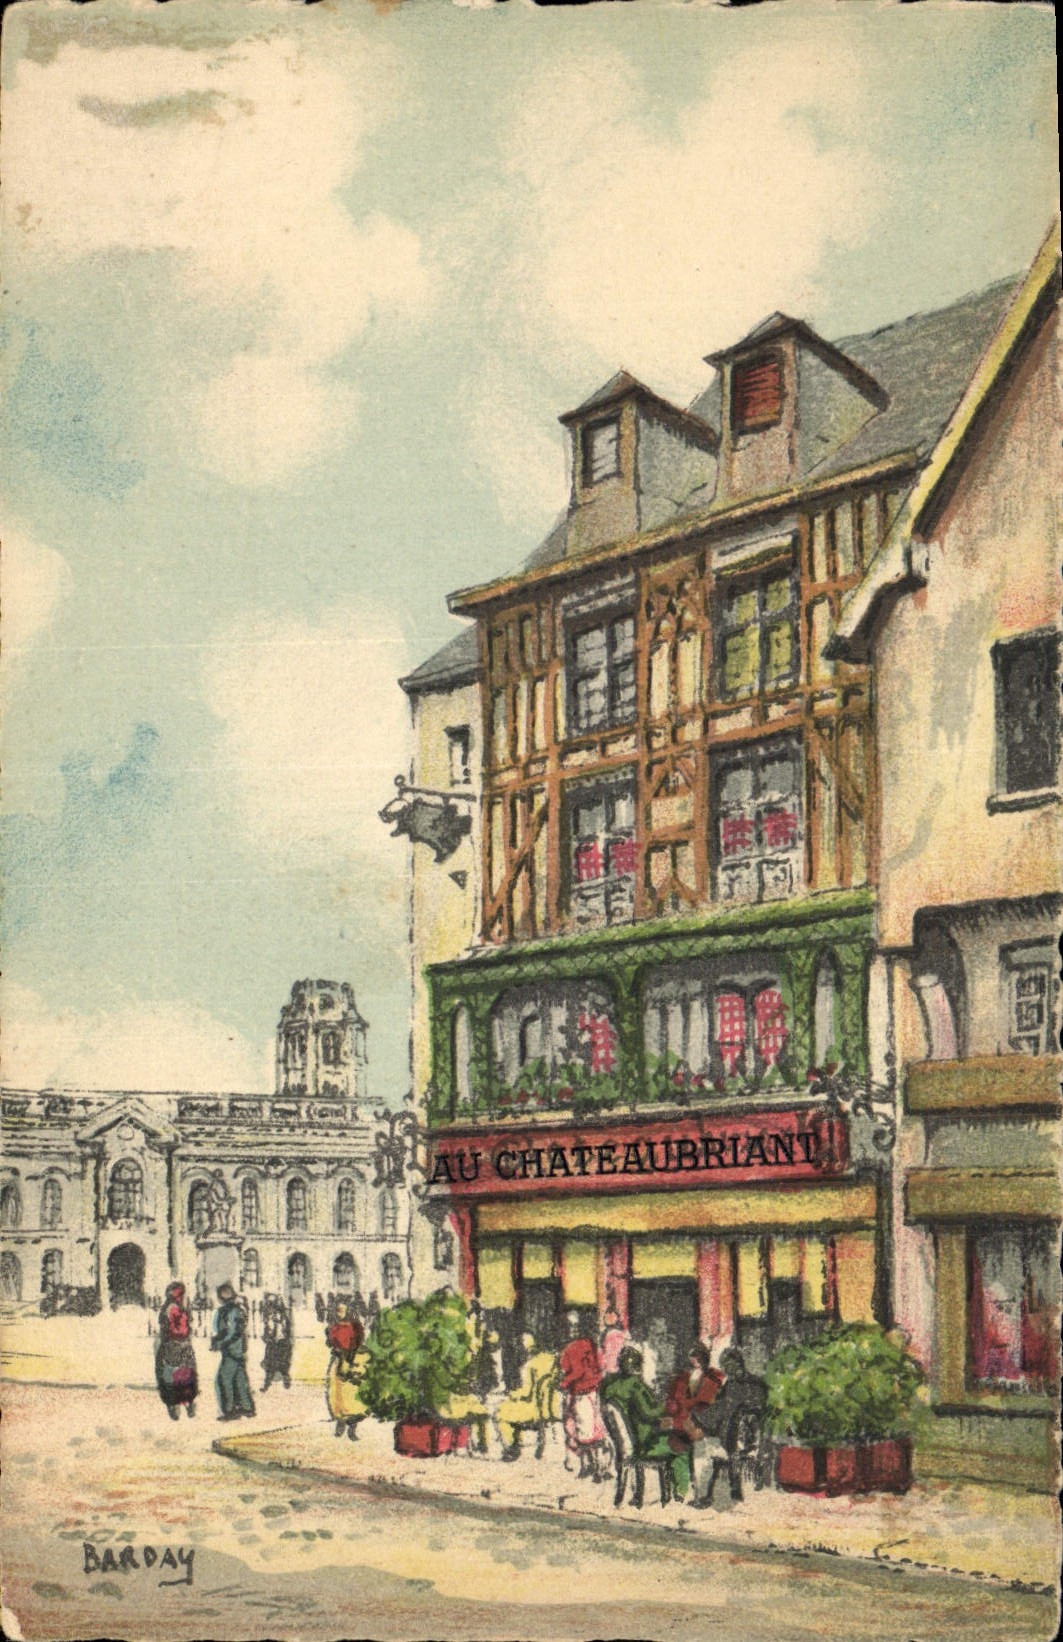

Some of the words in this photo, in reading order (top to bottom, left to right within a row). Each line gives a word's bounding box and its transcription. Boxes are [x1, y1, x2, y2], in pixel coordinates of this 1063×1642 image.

[427, 1152, 482, 1184] AU
[496, 1132, 819, 1180] CHATEAUBRIANT
[83, 1542, 195, 1587] BARDAY
